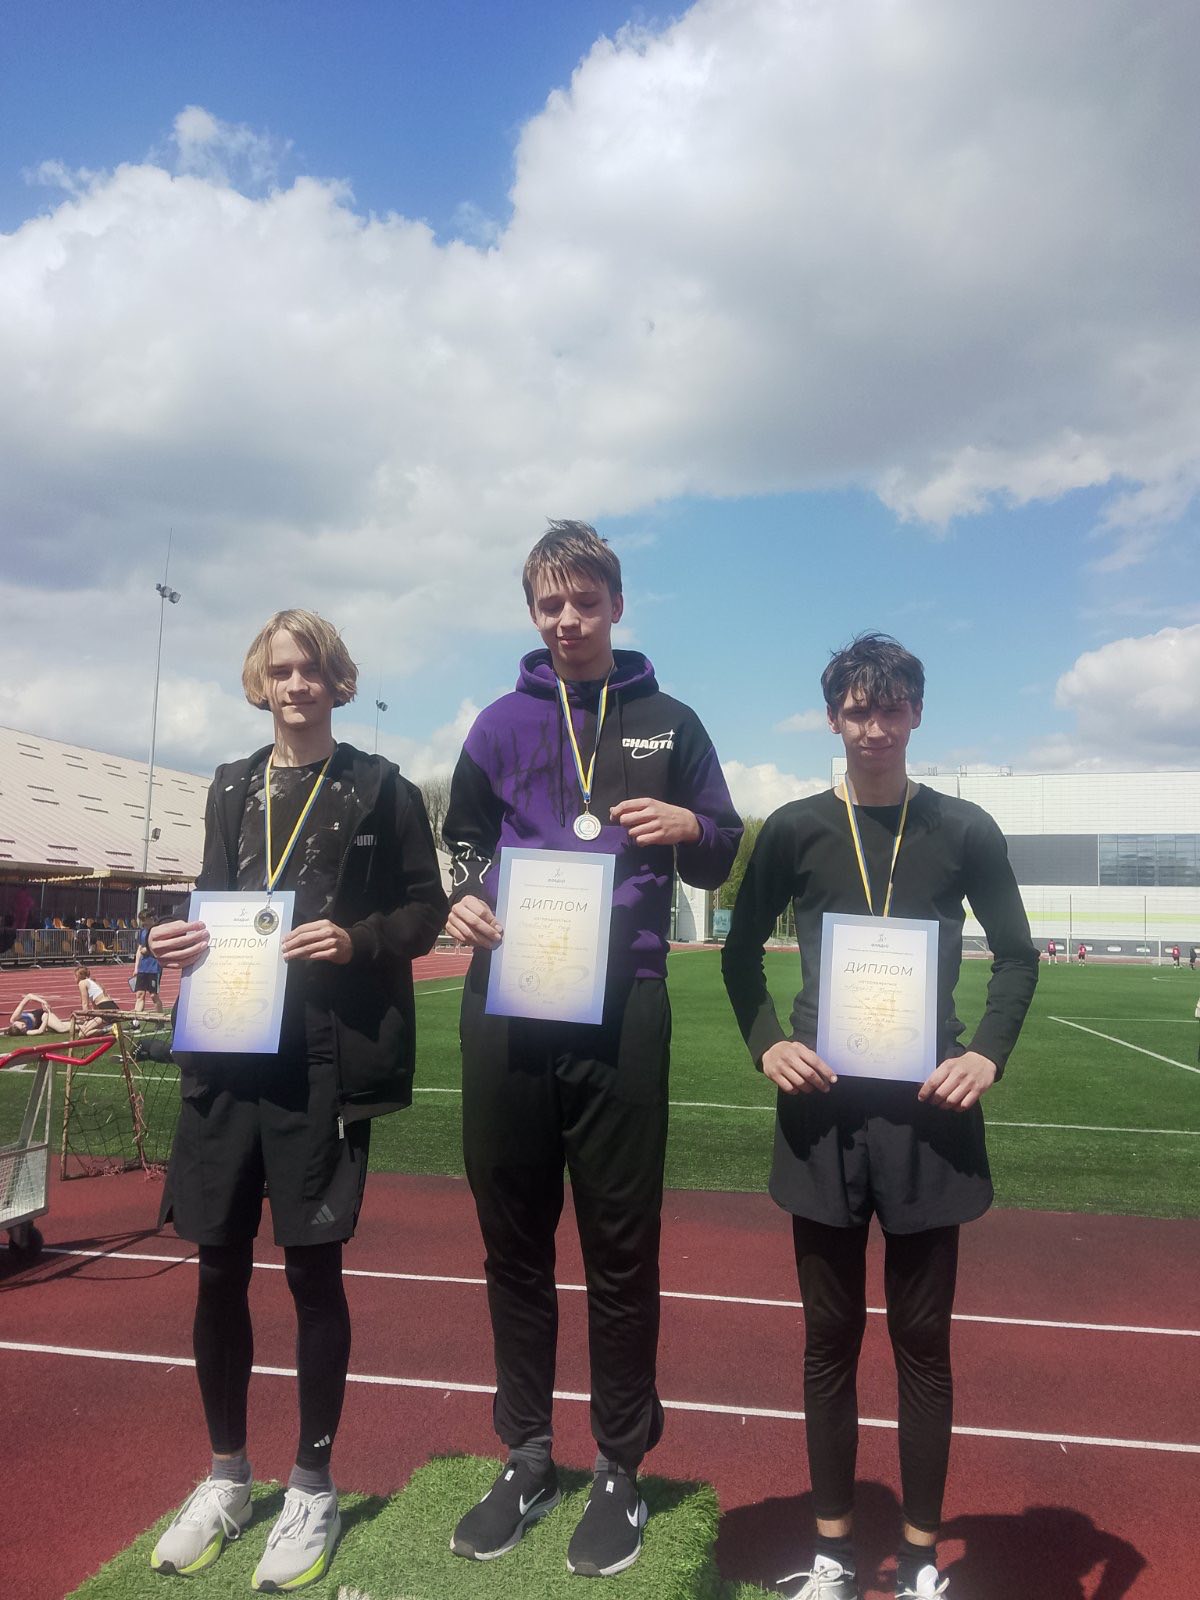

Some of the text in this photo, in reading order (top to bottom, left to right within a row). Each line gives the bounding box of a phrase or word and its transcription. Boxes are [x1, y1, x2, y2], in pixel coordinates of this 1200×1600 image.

[519, 897, 588, 913] ДИПЛОМ
[208, 937, 269, 949] ДИПЛОМ
[843, 961, 913, 977] ДИПЛОМ
